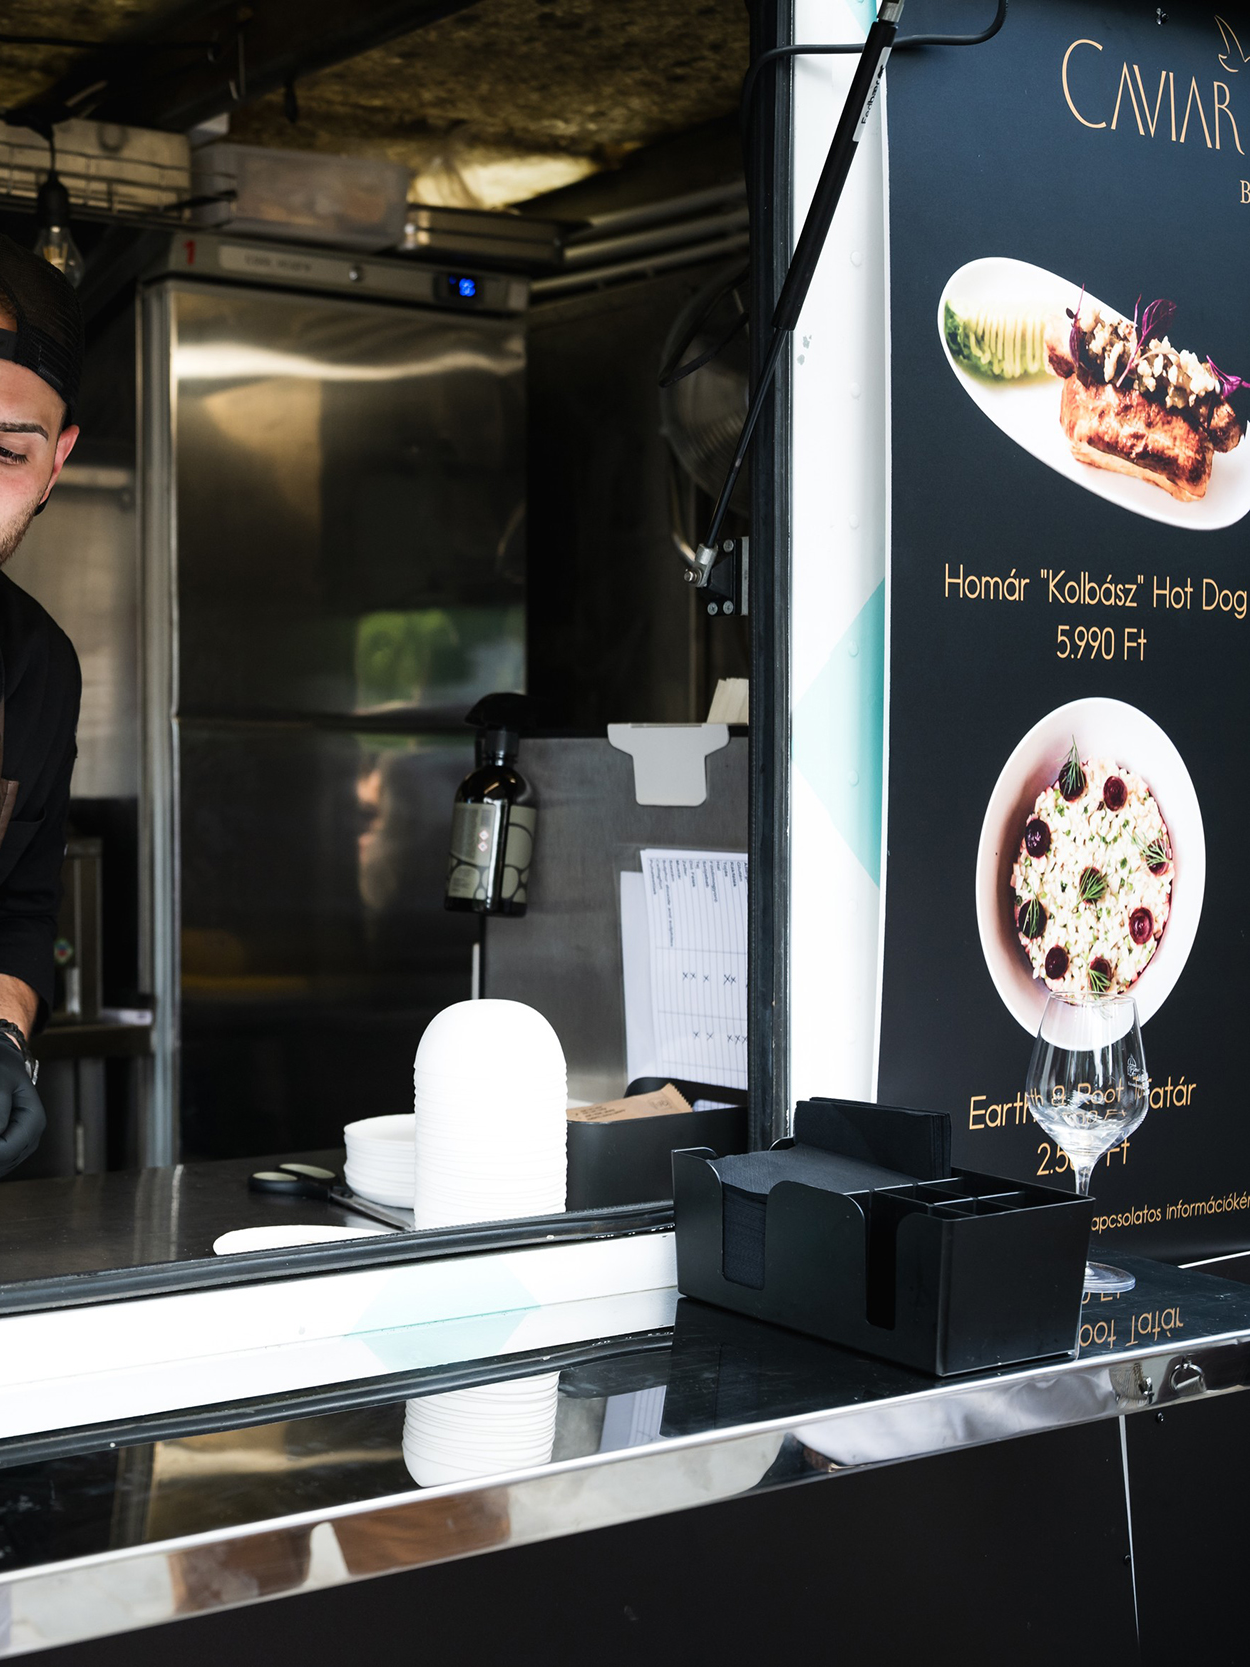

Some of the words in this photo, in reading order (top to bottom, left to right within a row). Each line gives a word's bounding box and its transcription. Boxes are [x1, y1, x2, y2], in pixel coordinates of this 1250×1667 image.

[1061, 38, 1246, 156] CAVIAR
[944, 562, 1030, 602] Homár
[1040, 568, 1145, 607] "Kolbász"
[1152, 575, 1194, 610] Hot
[1201, 577, 1248, 620] Dog
[1056, 624, 1116, 660] 5.990
[1123, 627, 1148, 661] Ft
[968, 1089, 1040, 1131] Earth
[1090, 1204, 1162, 1235] apcsolatos
